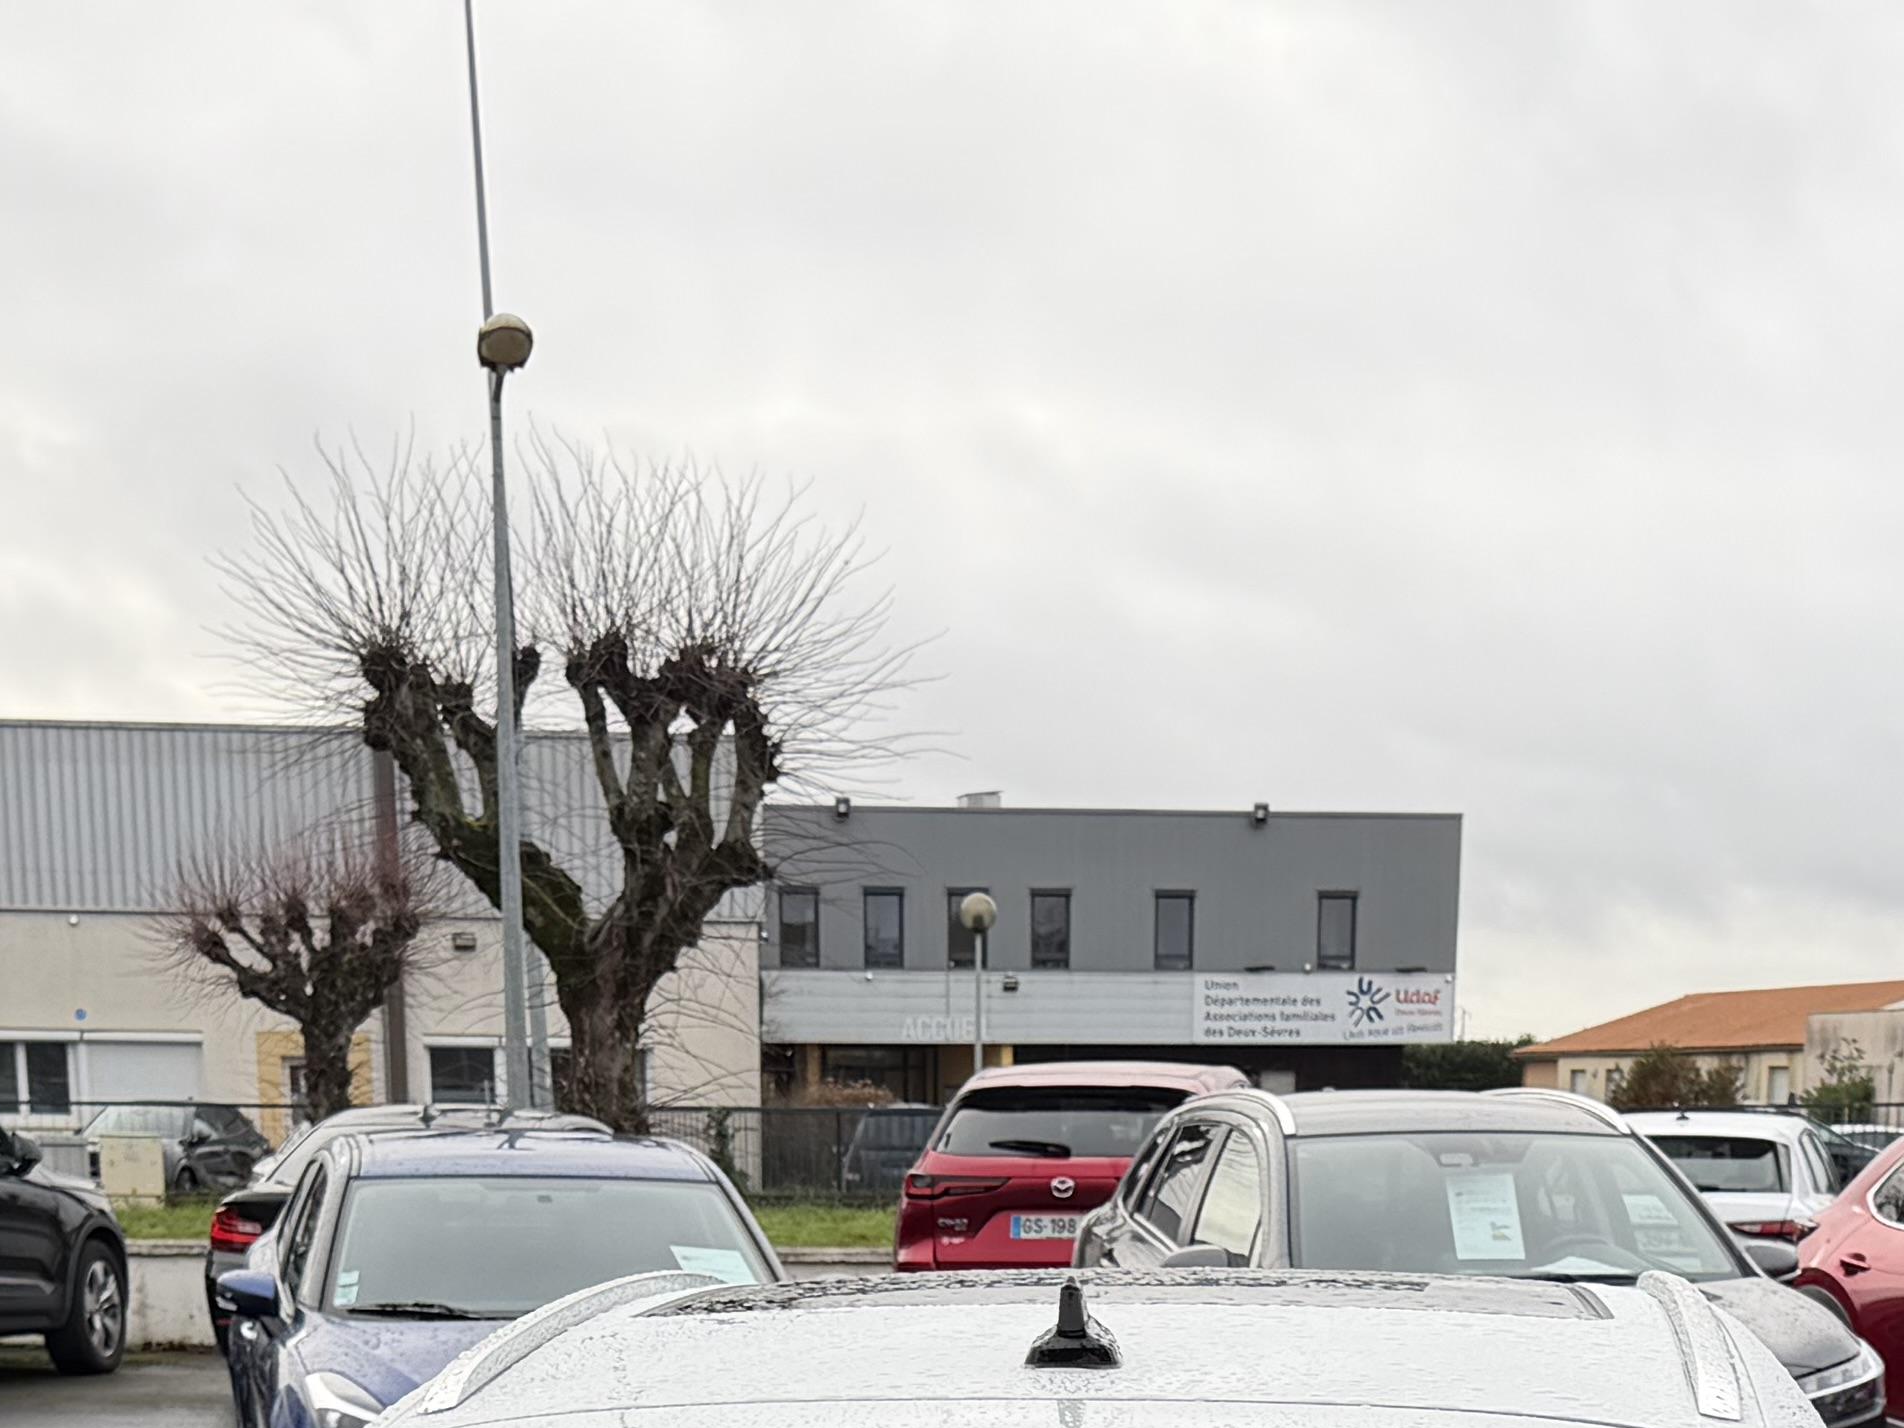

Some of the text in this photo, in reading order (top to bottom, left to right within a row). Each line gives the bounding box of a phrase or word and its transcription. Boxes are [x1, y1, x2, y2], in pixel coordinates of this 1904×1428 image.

[1204, 979, 1239, 991] Union
[1204, 994, 1321, 1008] Départementale des
[1203, 1010, 1276, 1022] Associations
[901, 1017, 993, 1041] ACCUEL
[1203, 1026, 1224, 1038] des
